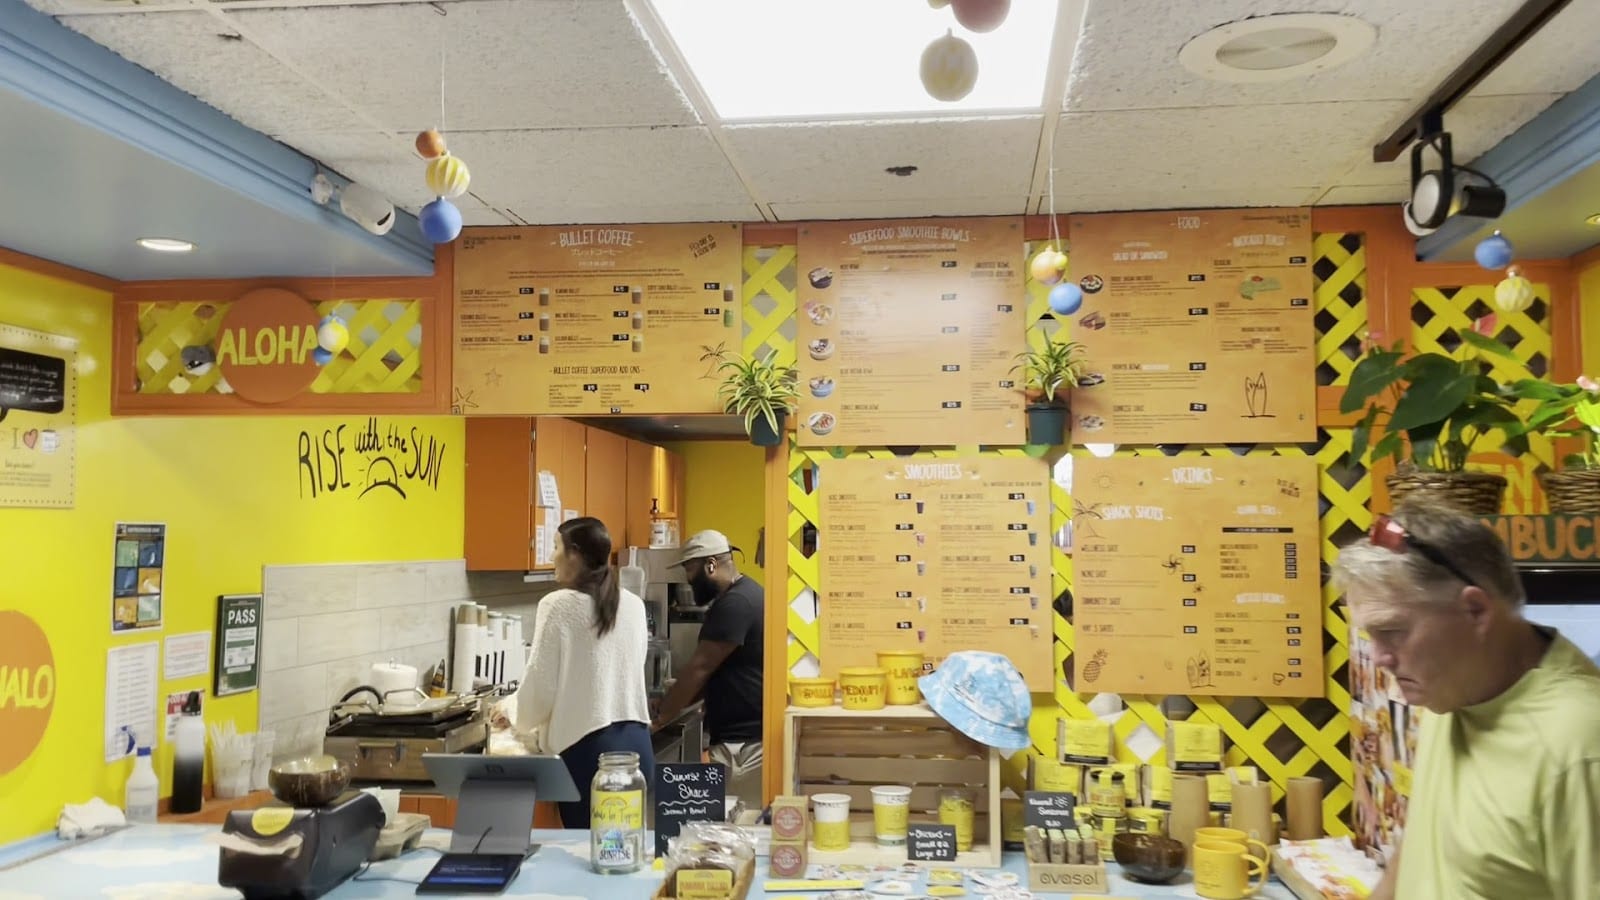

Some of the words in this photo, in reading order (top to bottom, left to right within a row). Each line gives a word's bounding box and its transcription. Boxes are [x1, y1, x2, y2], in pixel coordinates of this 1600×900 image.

[1175, 217, 1200, 229] FOOD
[559, 230, 595, 247] BULLET
[598, 229, 635, 247] COFFEE
[849, 229, 895, 245] SUPERFOOD
[897, 226, 938, 240] SMOOTHIE
[941, 228, 971, 243] BOWLS
[216, 323, 319, 366] ALOHA
[553, 366, 570, 375] BULLET
[571, 366, 588, 374] COFFEE
[298, 423, 351, 498] RISE
[354, 416, 382, 453] with
[385, 423, 407, 453] the
[404, 426, 446, 490] SUN
[904, 463, 962, 480] SMOOTHIES
[1172, 468, 1213, 485] DRINKS
[1101, 505, 1132, 520] SHACK
[1135, 505, 1164, 520] SHOTS
[227, 608, 256, 625] PASS
[662, 766, 700, 783] Sunrise
[678, 783, 710, 799] Shack
